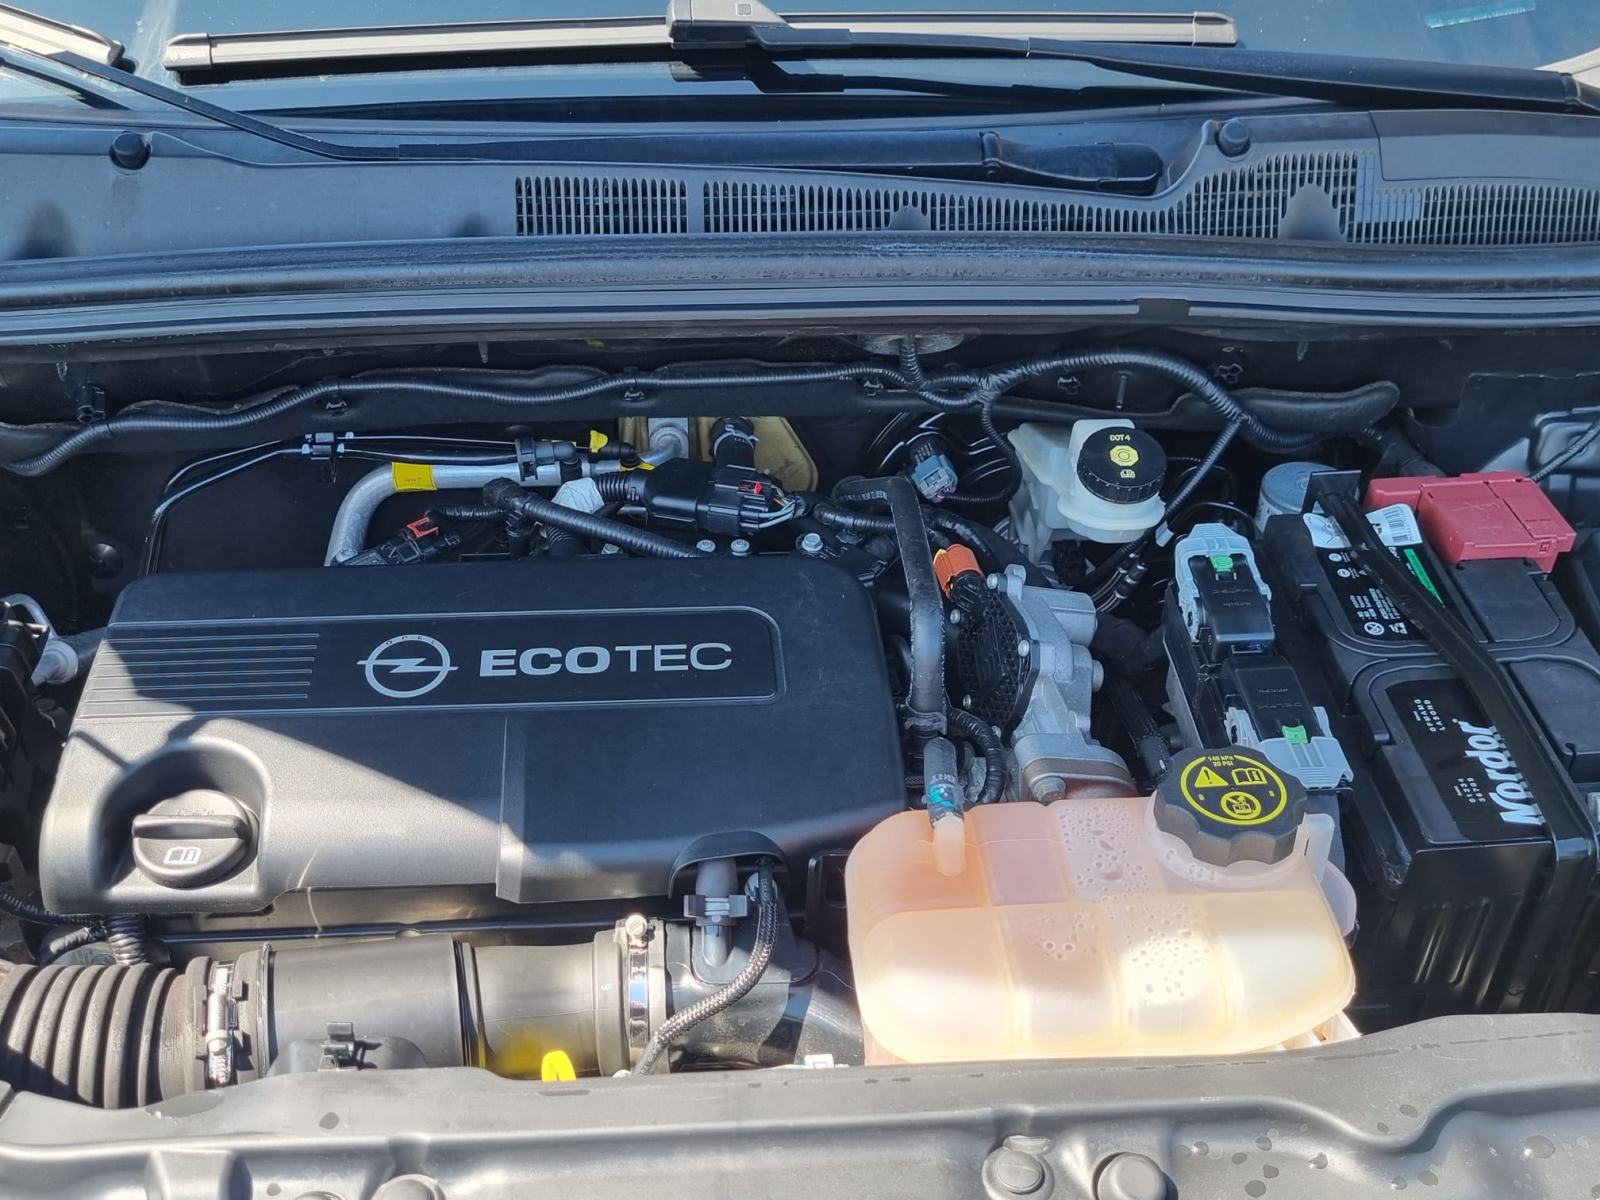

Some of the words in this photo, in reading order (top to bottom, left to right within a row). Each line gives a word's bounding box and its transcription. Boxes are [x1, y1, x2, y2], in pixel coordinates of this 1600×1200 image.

[1109, 434, 1124, 442] DOT
[479, 642, 733, 677] ECOTEC
[1457, 720, 1544, 826] Nordor
